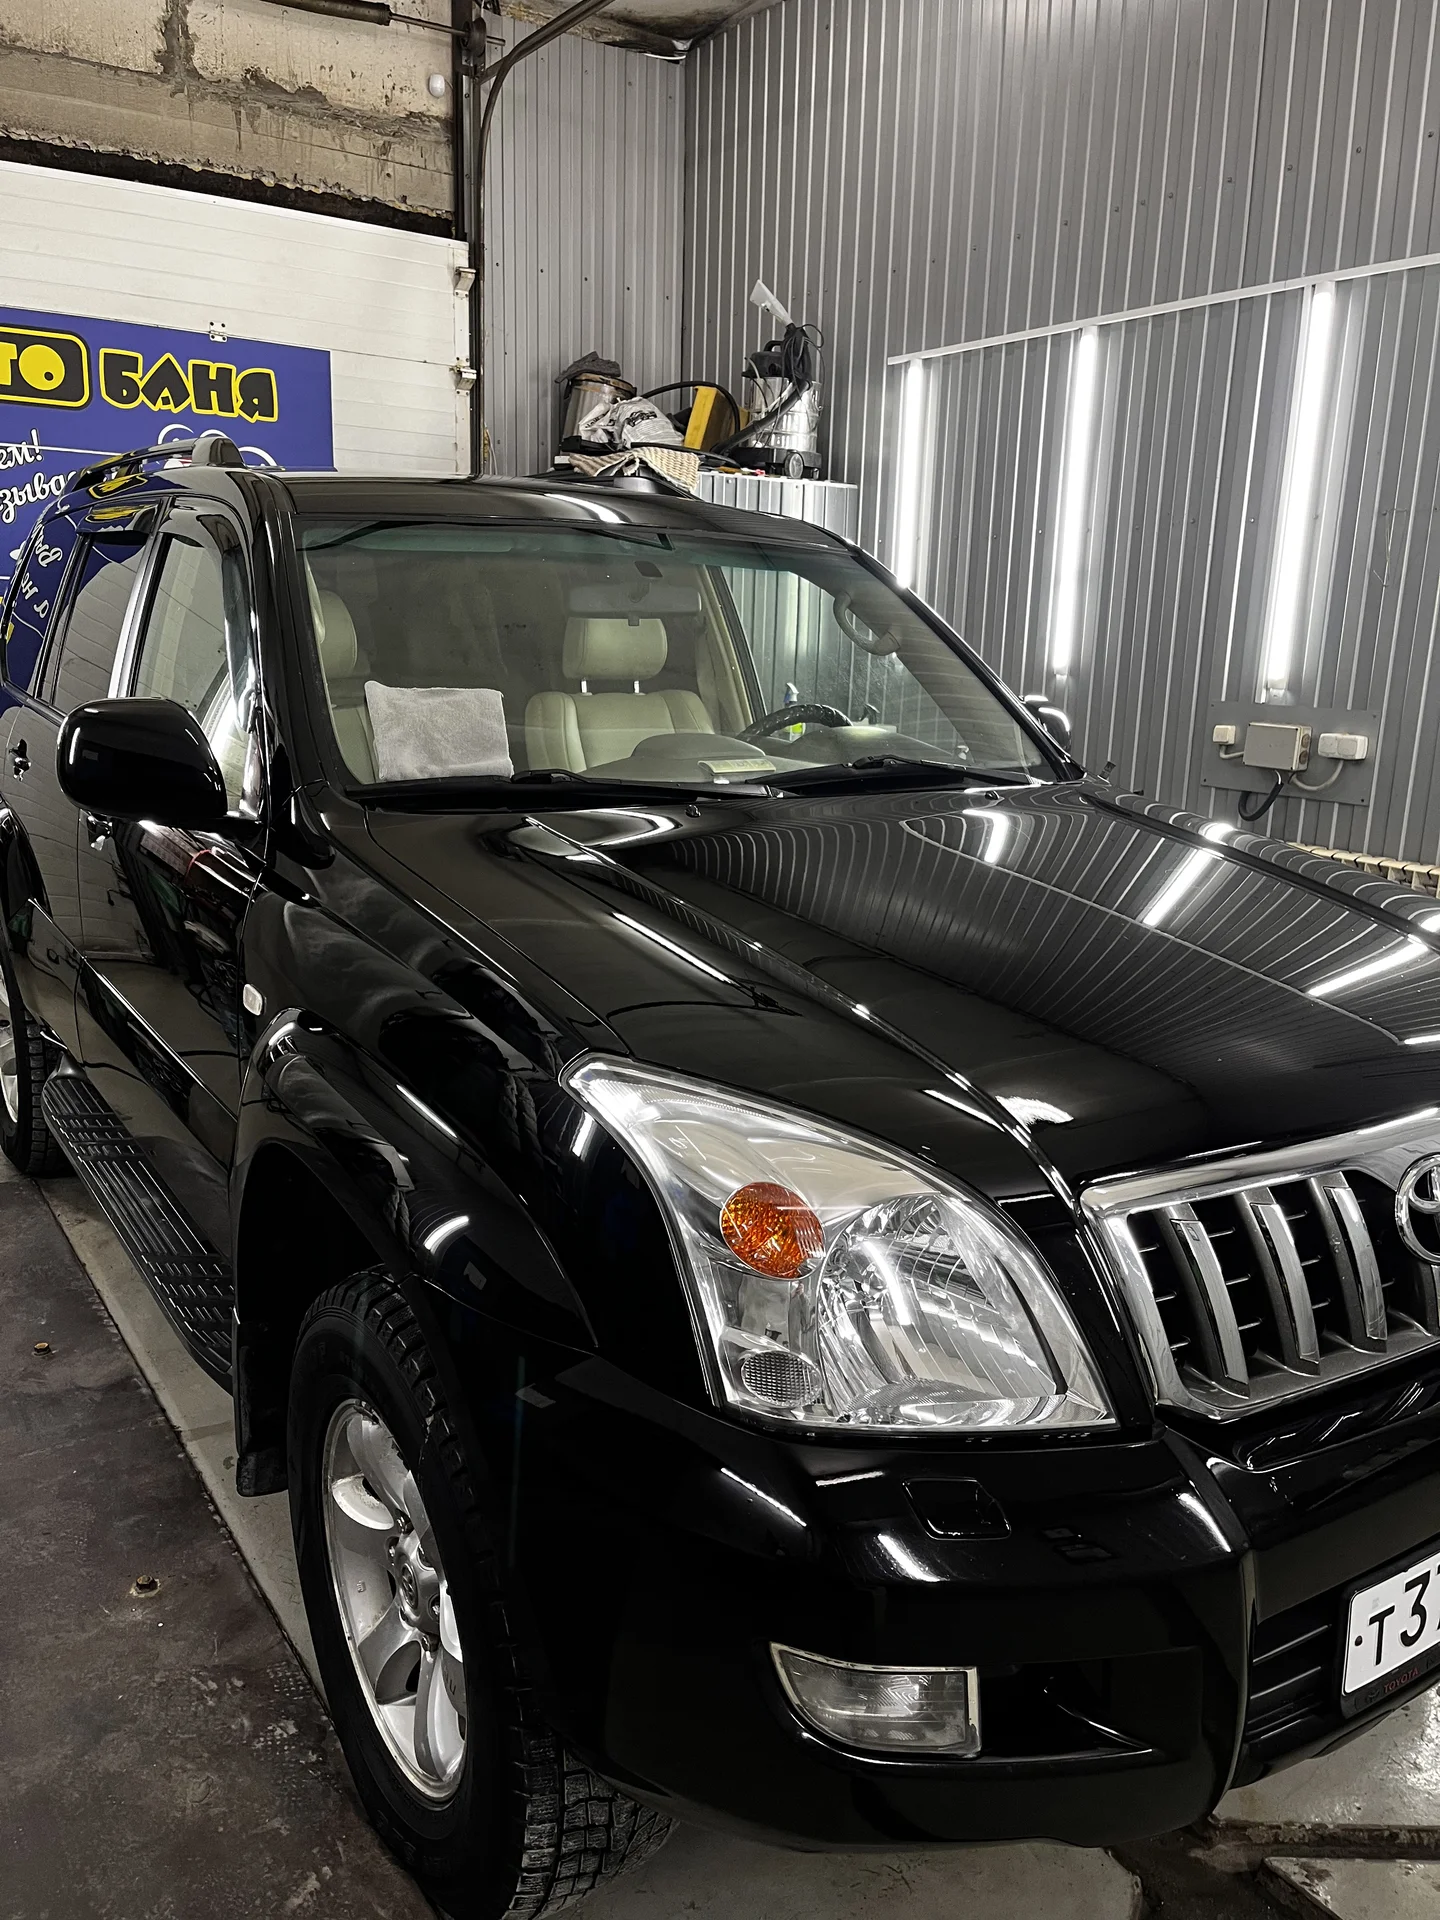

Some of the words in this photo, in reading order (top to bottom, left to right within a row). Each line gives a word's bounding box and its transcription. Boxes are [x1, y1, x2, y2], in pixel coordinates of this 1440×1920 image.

[99, 348, 279, 423] БАНЯ
[0, 471, 77, 524] зыва
[1368, 1563, 1440, 1666] Т3
[1384, 1667, 1420, 1695] TOYOTA
